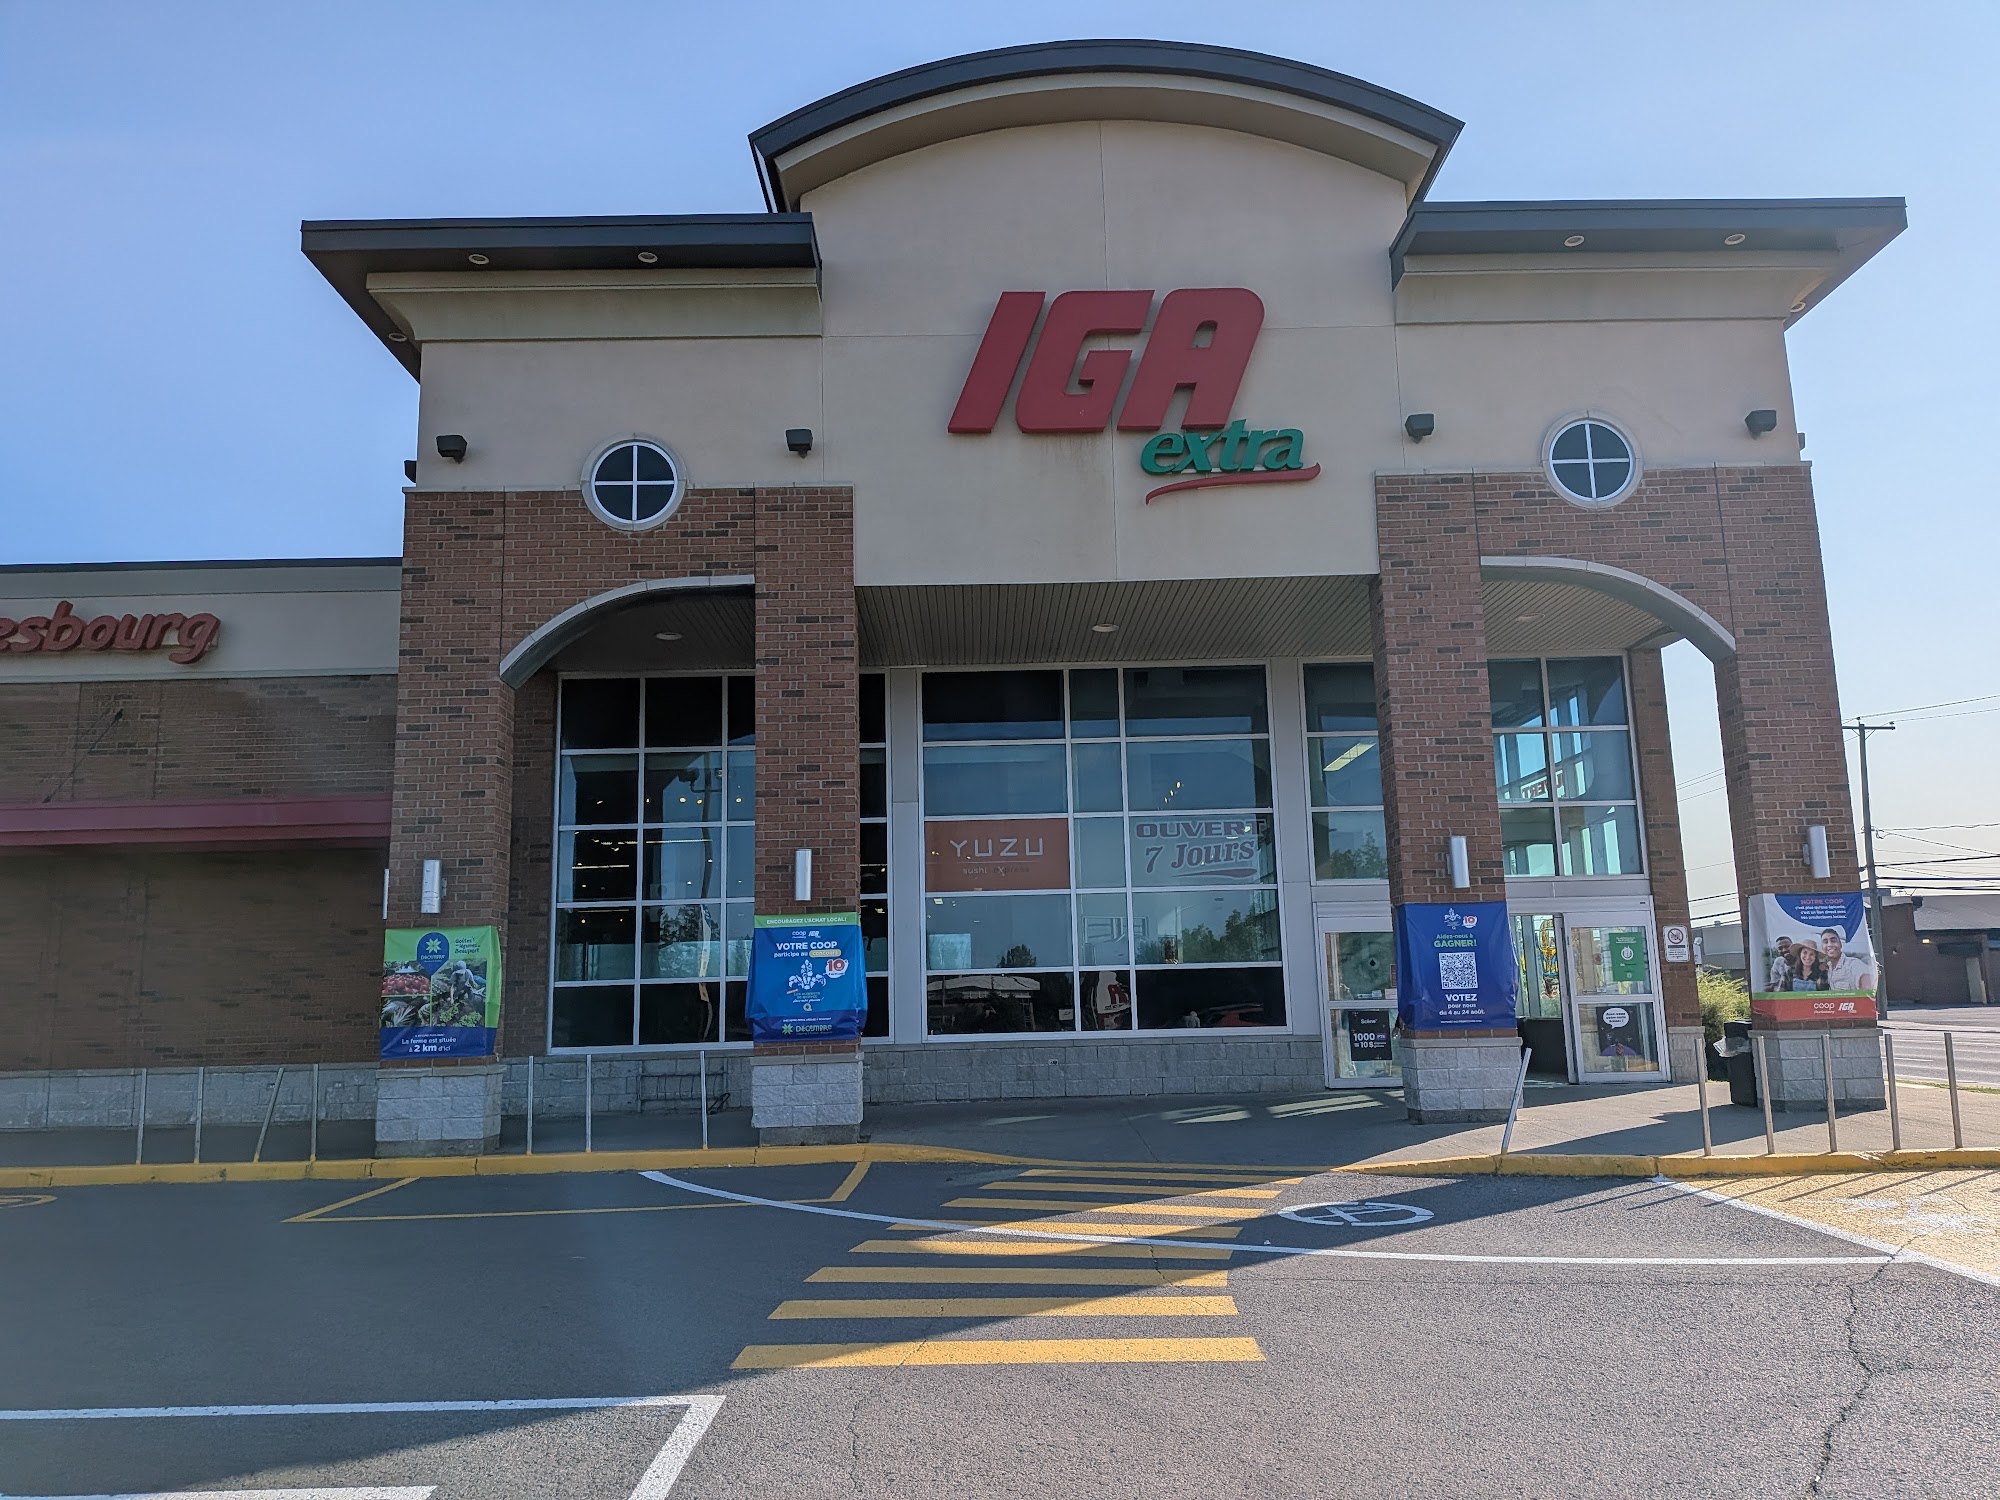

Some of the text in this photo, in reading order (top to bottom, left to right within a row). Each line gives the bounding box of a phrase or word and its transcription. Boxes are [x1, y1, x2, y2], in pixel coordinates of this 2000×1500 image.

[948, 287, 1265, 433] IGA
[1141, 419, 1304, 474] extra
[1136, 819, 1266, 838] OUVERT
[949, 837, 1044, 857] YUZU
[1145, 840, 1255, 874] 7 Jours
[962, 866, 987, 874] sushi
[810, 941, 838, 949] COOP
[1838, 1002, 1854, 1011] IGA
[1353, 1033, 1375, 1041] 1000
